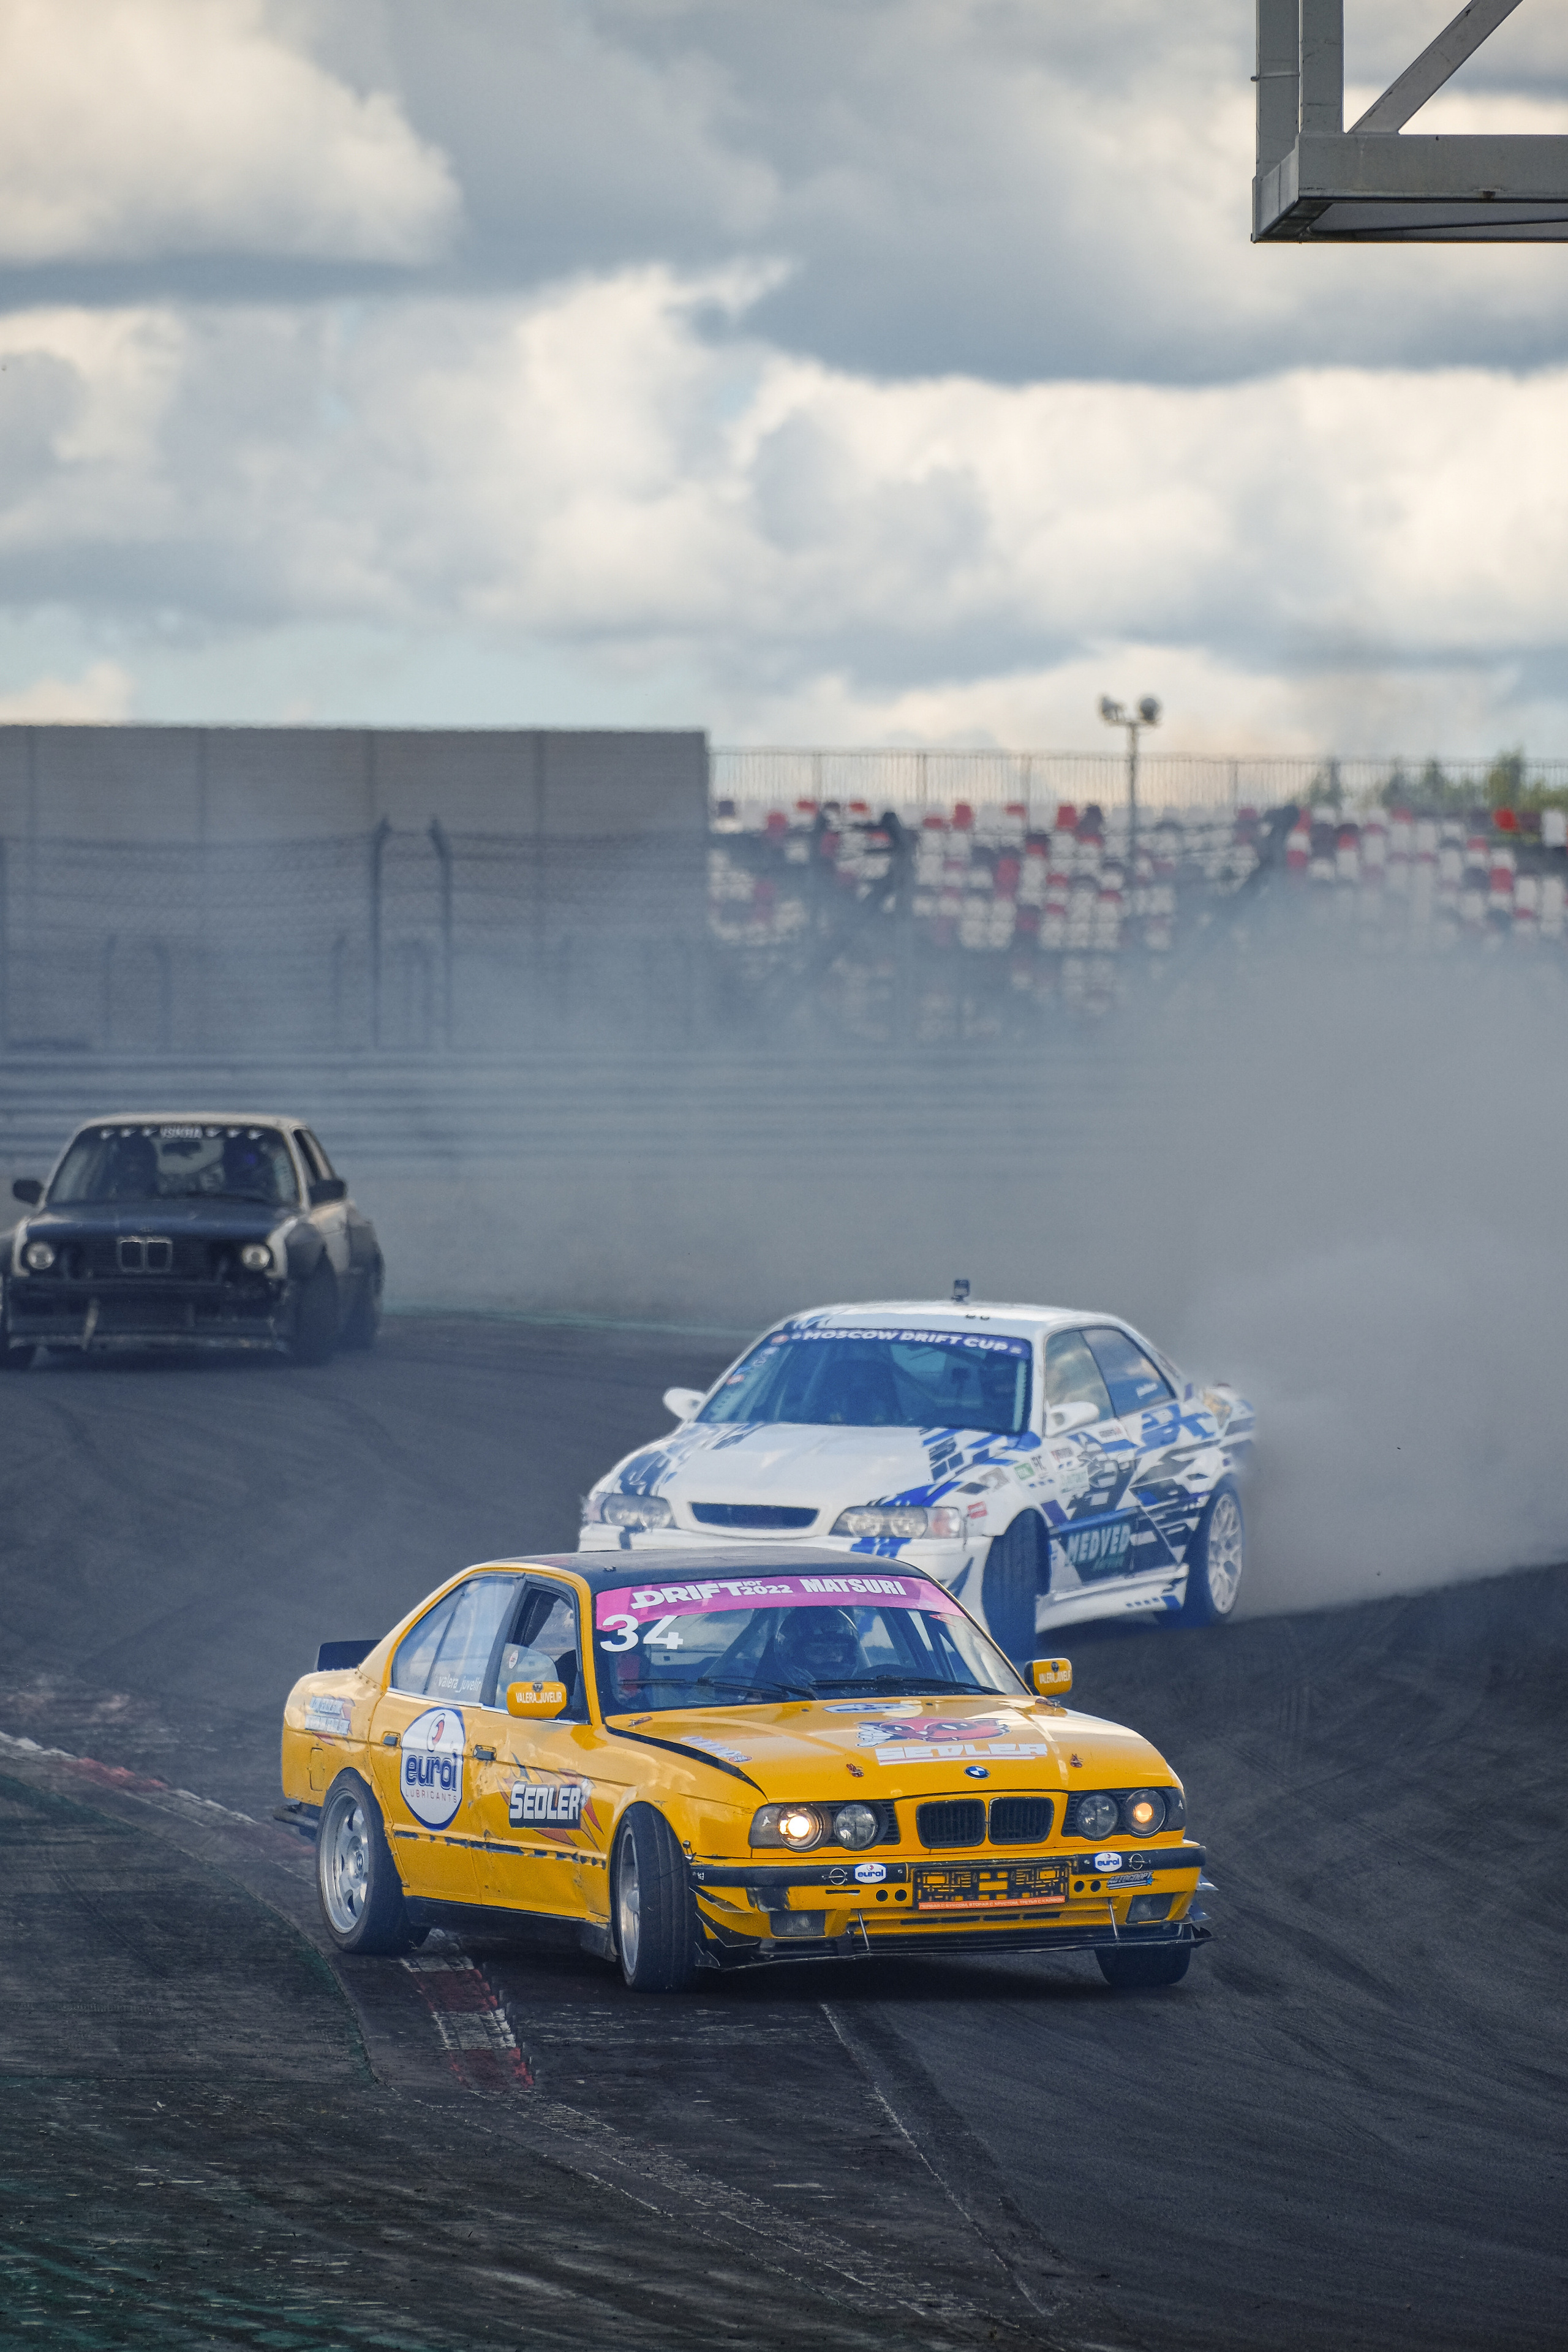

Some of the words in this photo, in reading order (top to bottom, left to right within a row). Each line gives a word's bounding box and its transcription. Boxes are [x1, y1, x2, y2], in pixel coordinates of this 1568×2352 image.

[804, 1329, 898, 1341] MOSCOW
[899, 1331, 963, 1346] DRIFT
[963, 1336, 1009, 1351] CUP
[1065, 1523, 1131, 1567] MEDVED
[630, 1581, 745, 1610] DRIFT
[740, 1585, 794, 1596] 2022
[799, 1578, 907, 1596] MATSURI
[600, 1614, 684, 1652] 34
[516, 1692, 562, 1704] VALERA_JUVELIR
[875, 1743, 1047, 1760] SEDLER
[405, 1752, 458, 1792] eurol
[405, 1789, 457, 1803] LUBRICANTS
[510, 1784, 581, 1820] SEDLER
[1097, 1858, 1120, 1866] eurol
